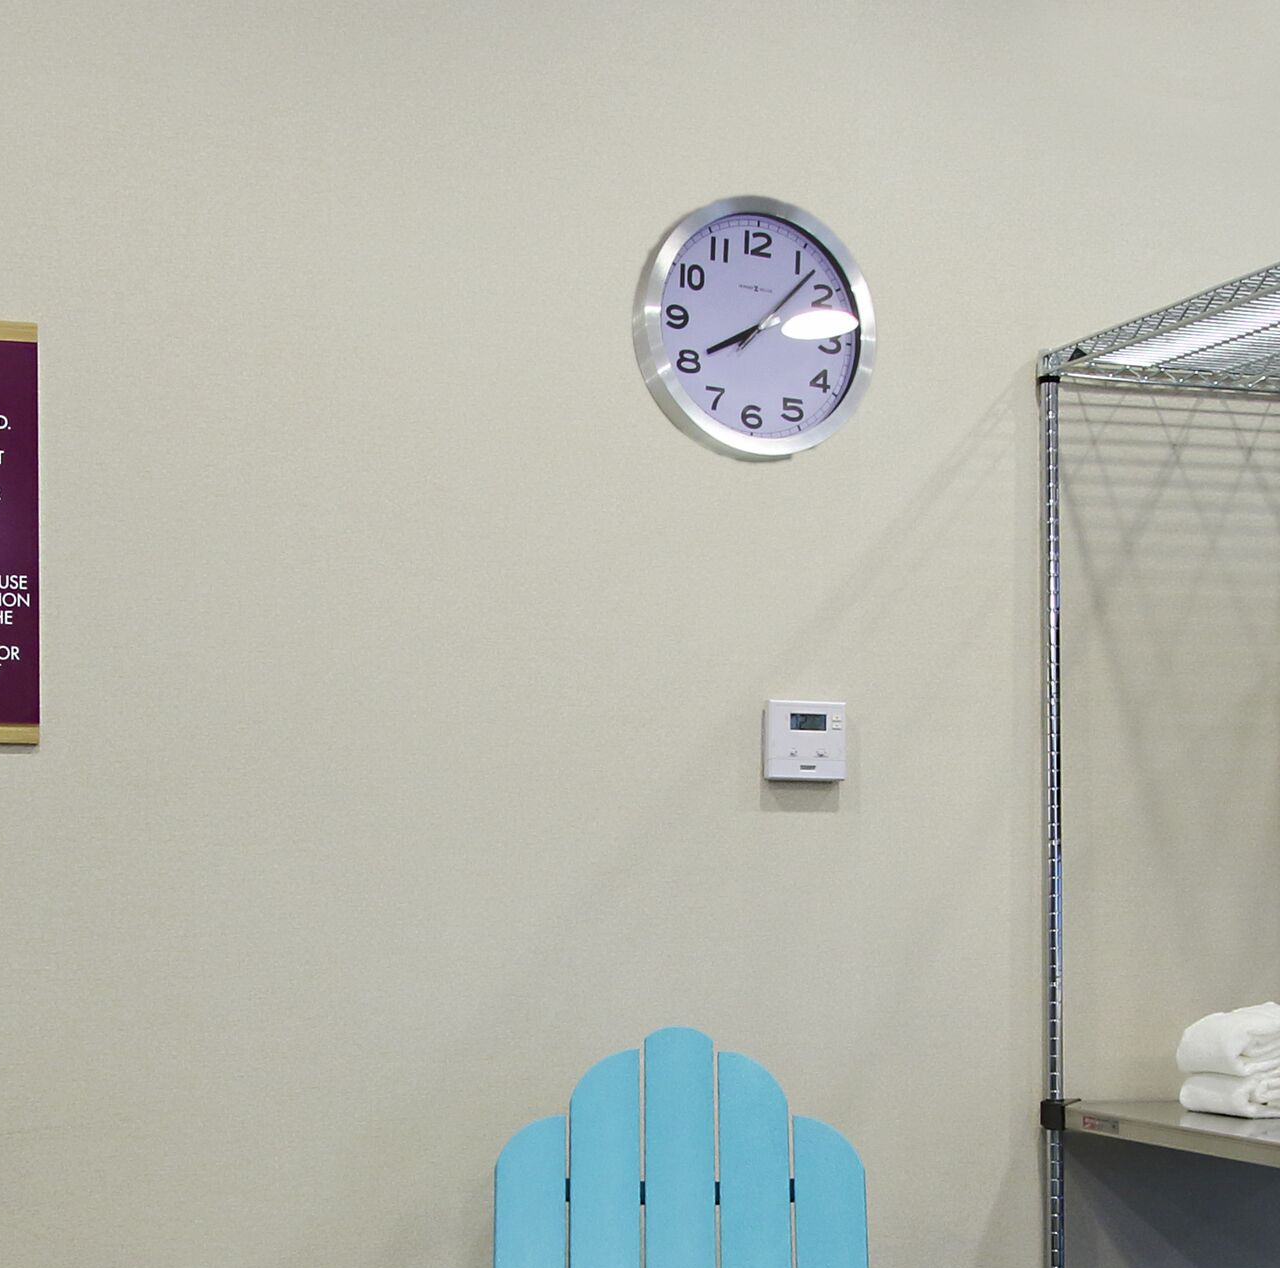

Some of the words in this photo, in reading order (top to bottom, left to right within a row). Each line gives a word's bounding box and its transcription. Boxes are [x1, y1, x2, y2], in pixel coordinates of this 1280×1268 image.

[710, 236, 729, 263] 11
[744, 230, 772, 258] 12
[796, 250, 801, 275] 1
[679, 263, 705, 291] 10
[811, 284, 833, 308] 2
[666, 304, 689, 329] 9
[676, 349, 701, 373] 8
[809, 369, 831, 393] 4
[705, 385, 725, 411] 7
[781, 397, 804, 422] 5
[741, 405, 763, 429] 6
